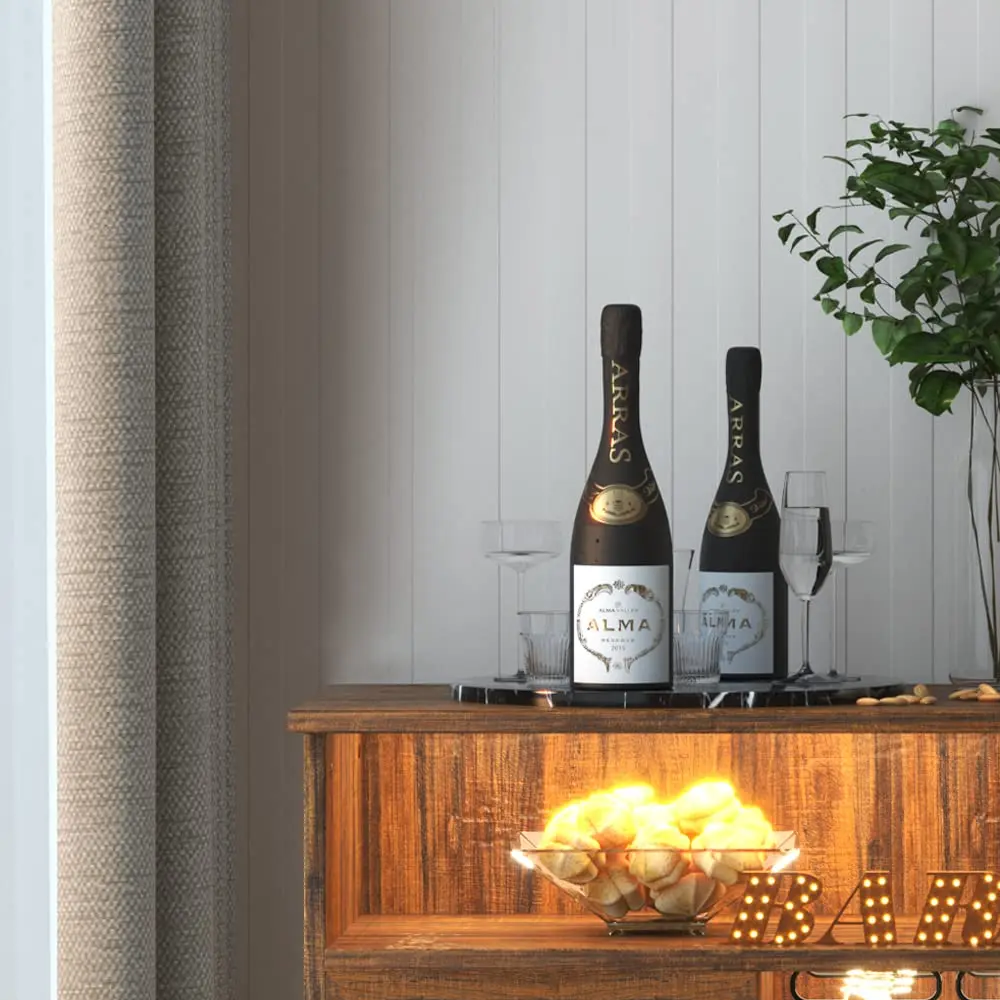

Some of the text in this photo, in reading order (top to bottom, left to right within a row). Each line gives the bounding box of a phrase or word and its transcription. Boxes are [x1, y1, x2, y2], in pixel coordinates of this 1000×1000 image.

[609, 359, 632, 464] ARRAS
[727, 396, 744, 484] ARRAS
[586, 618, 652, 632] ALMA
